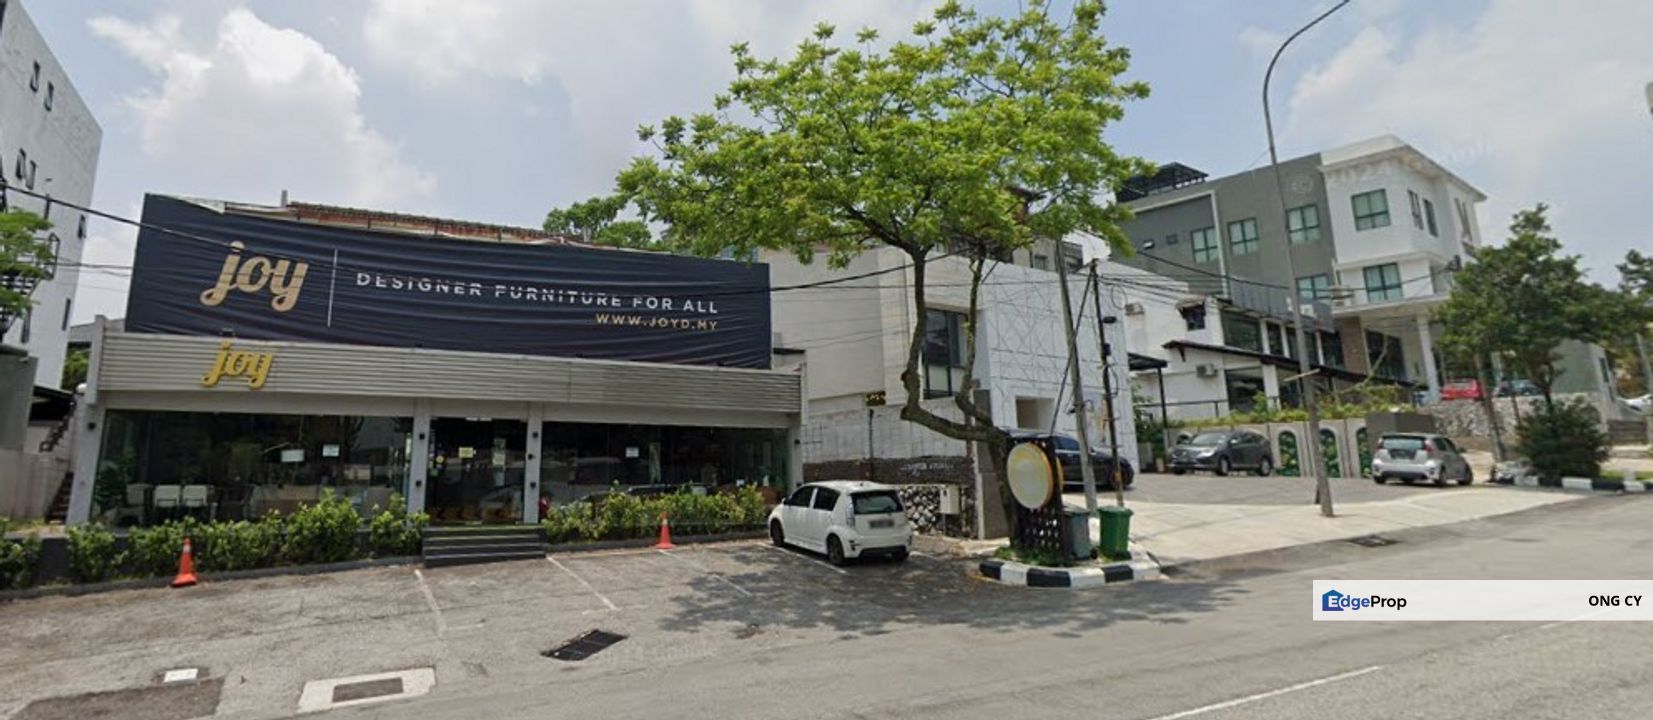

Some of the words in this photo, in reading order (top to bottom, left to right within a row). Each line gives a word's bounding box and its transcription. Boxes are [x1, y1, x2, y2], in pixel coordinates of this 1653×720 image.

[200, 241, 309, 312] joy
[356, 272, 482, 296] DESIGNER
[494, 284, 622, 307] FURNITURE
[632, 296, 673, 310] FOR
[683, 301, 719, 314] ALL
[595, 313, 719, 331] WWW.JOYD.MY
[201, 339, 273, 389] joy
